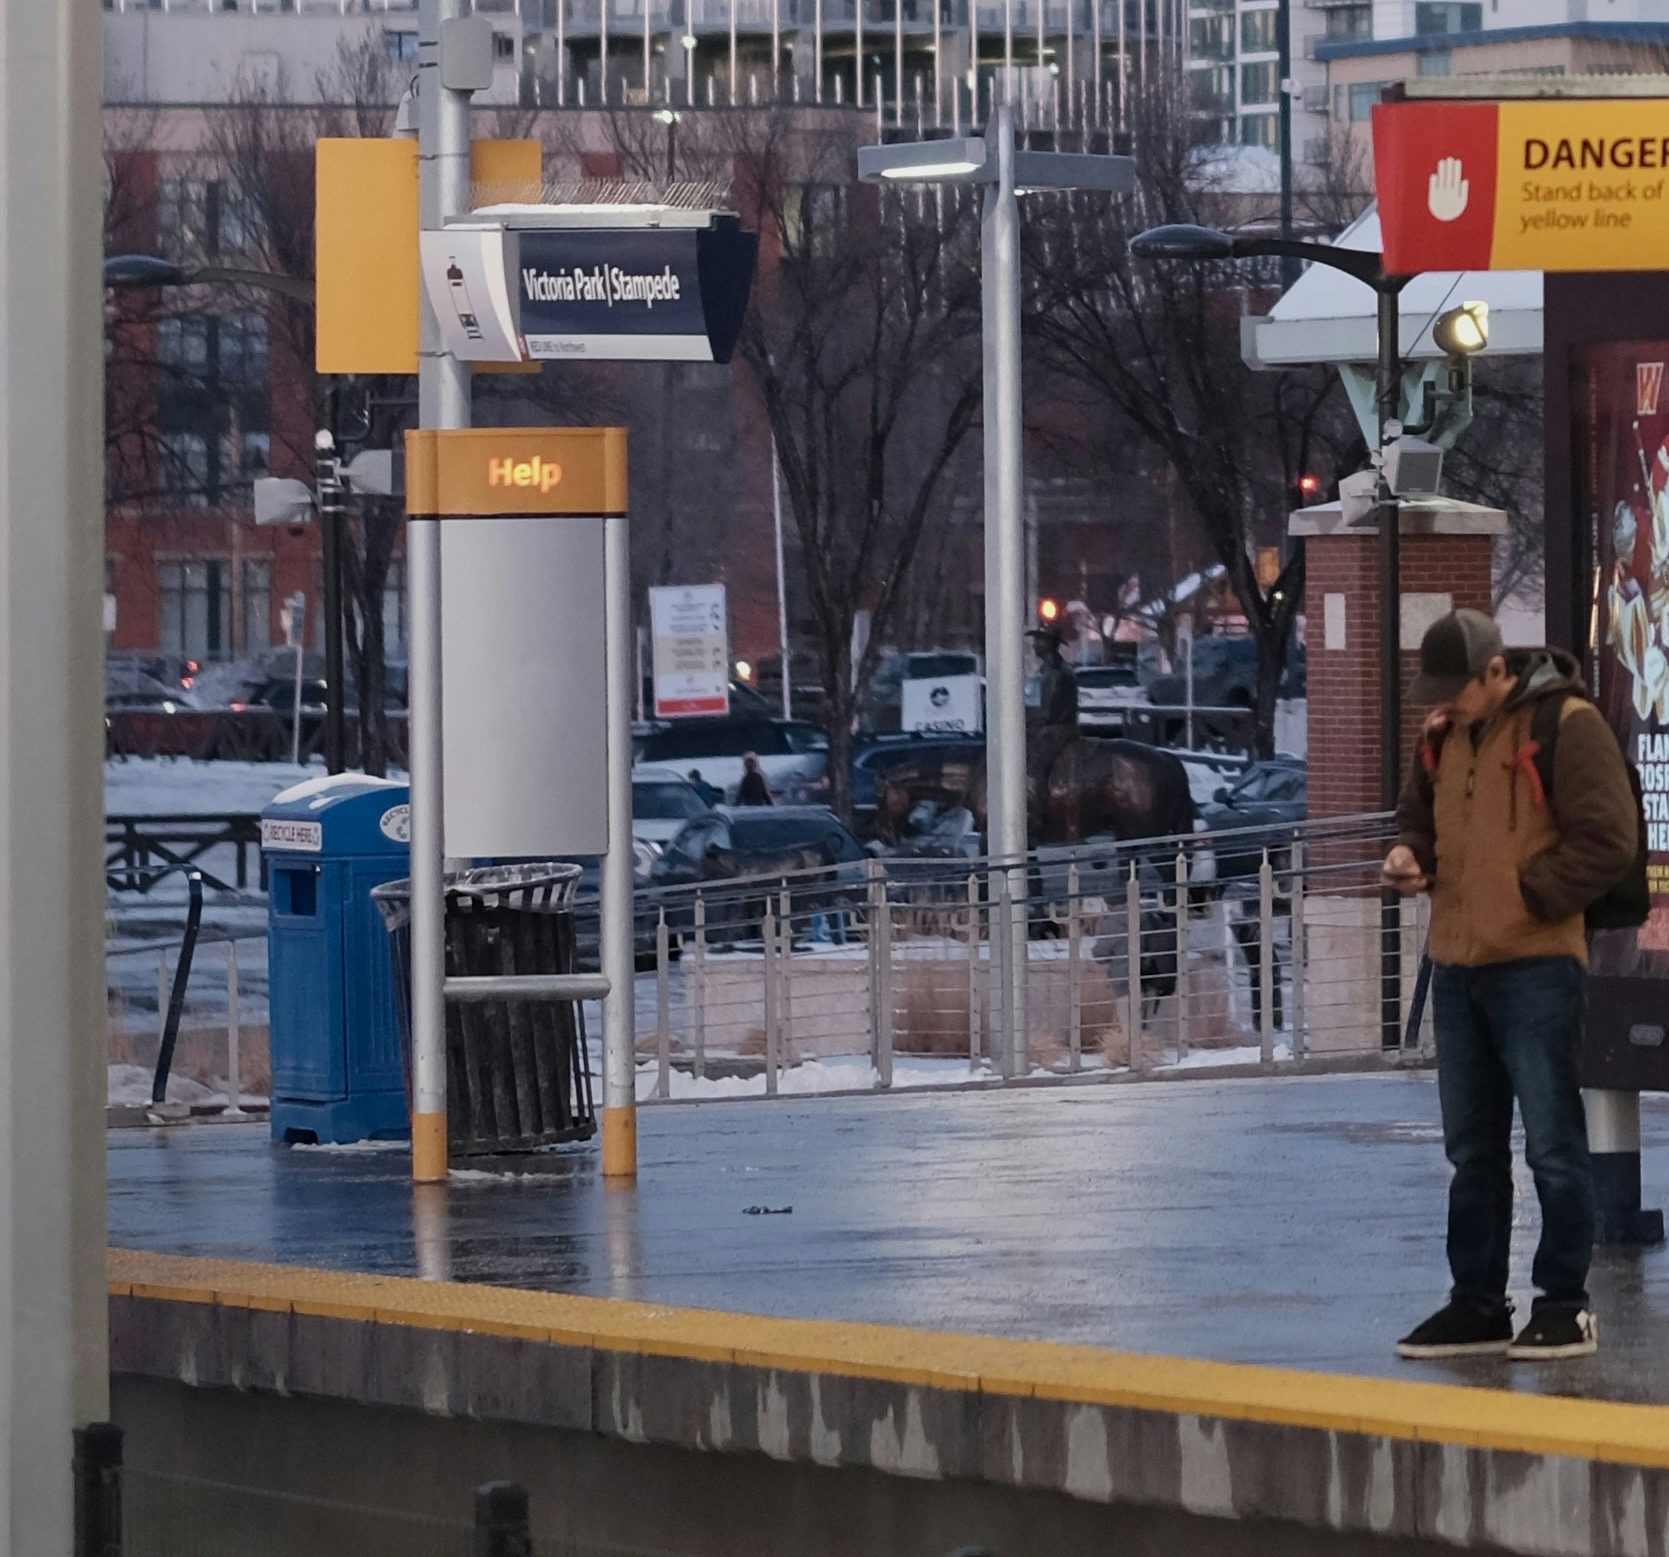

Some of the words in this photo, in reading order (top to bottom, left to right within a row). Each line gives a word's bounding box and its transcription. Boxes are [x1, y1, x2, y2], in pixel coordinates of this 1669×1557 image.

[1521, 180, 1583, 203] Stand
[1587, 179, 1637, 203] back
[1642, 178, 1665, 202] of
[1518, 208, 1588, 235] yellow
[1593, 208, 1632, 229] line
[523, 268, 575, 302] Victoria
[573, 265, 607, 302] Park
[611, 265, 681, 309] Stampede
[489, 456, 561, 494] Help
